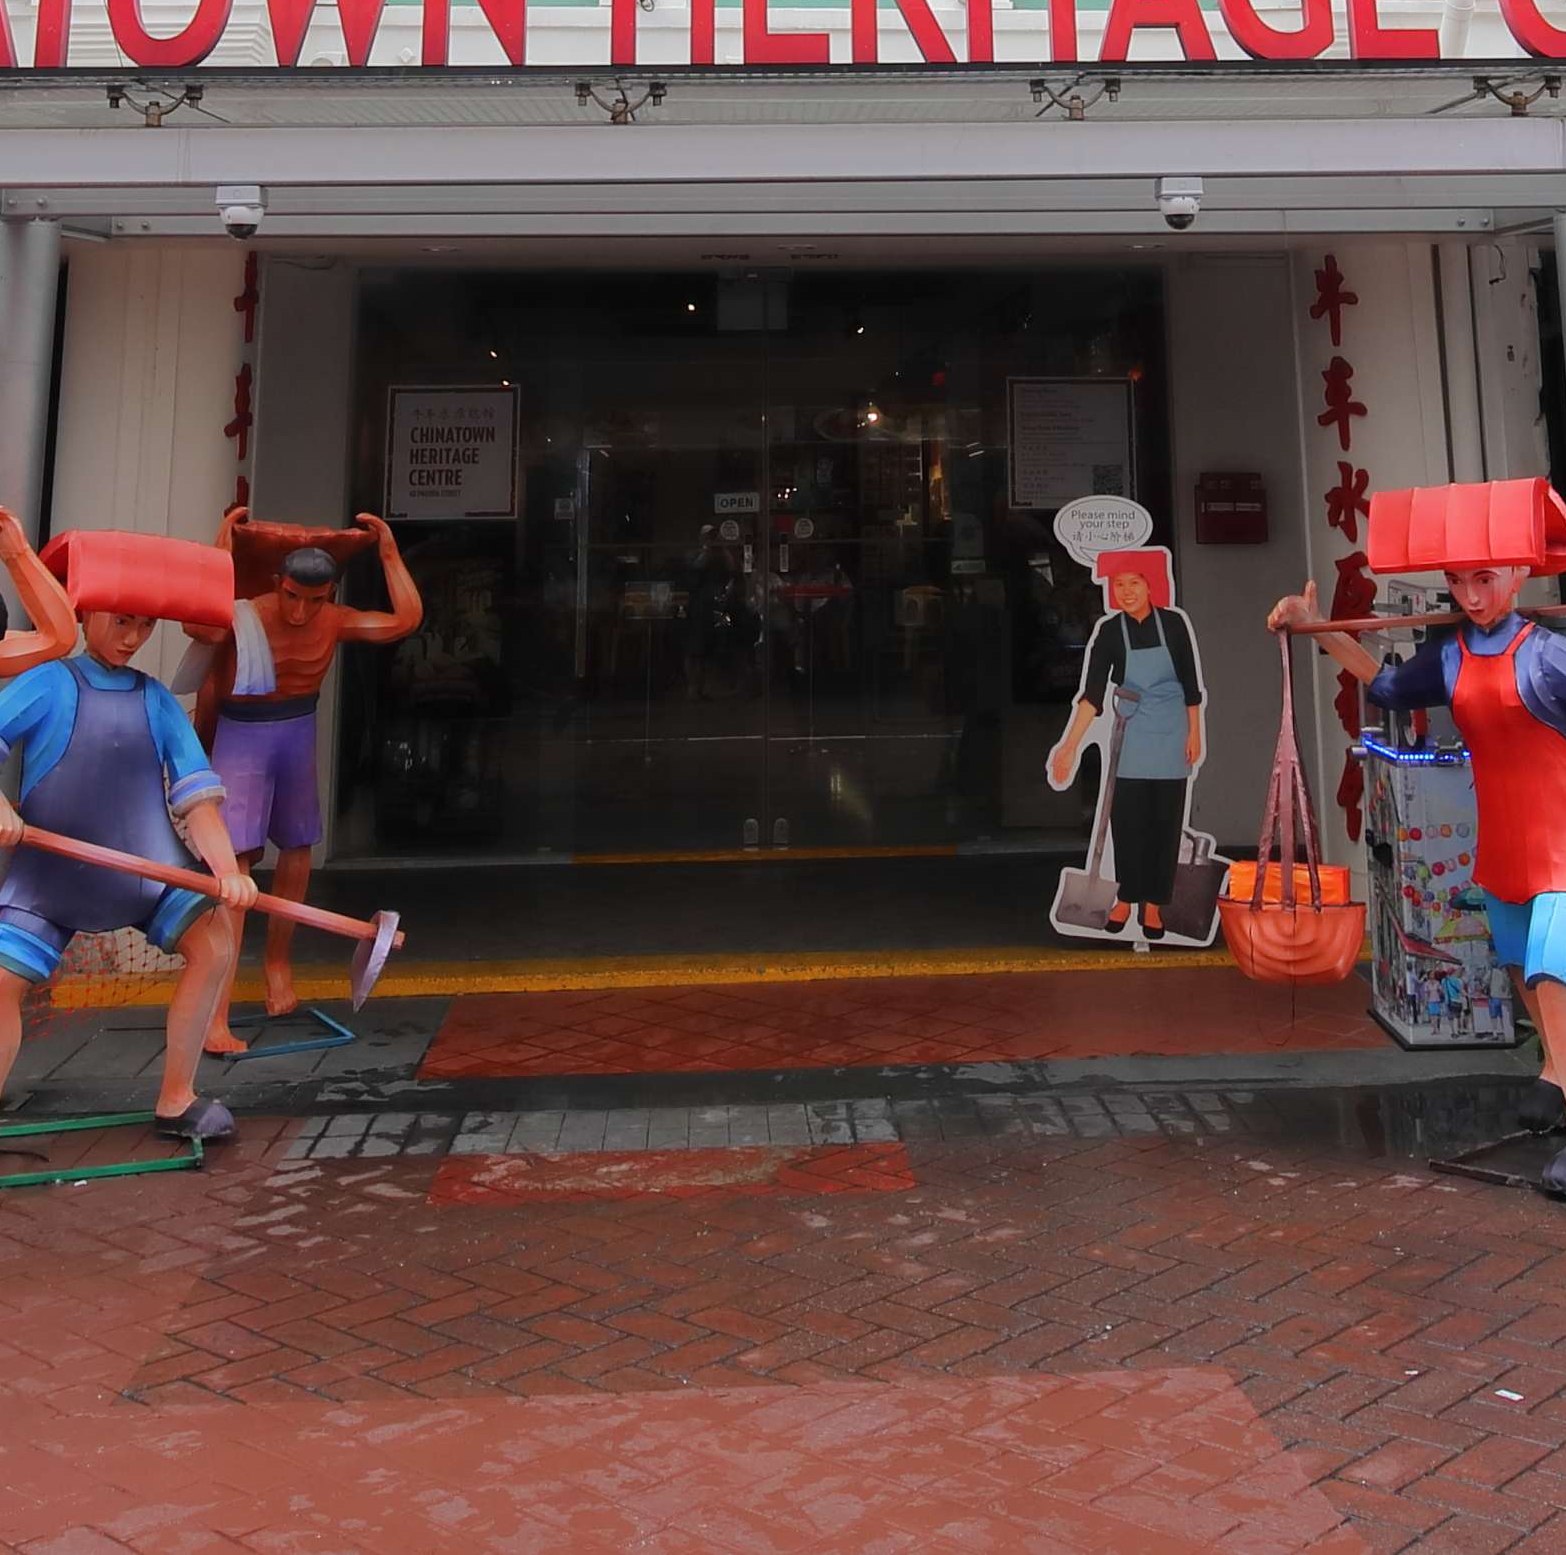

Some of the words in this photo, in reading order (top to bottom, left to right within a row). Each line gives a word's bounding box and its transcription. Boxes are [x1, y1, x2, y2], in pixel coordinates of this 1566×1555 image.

[410, 426, 496, 444] CHINATOWN
[409, 447, 480, 465] HERITAGE
[408, 469, 463, 486] CENTRE
[720, 497, 754, 509] OPEN
[1071, 510, 1105, 521] Please
[1106, 509, 1136, 521] mind
[1079, 521, 1104, 531] your
[1106, 520, 1130, 531] step
